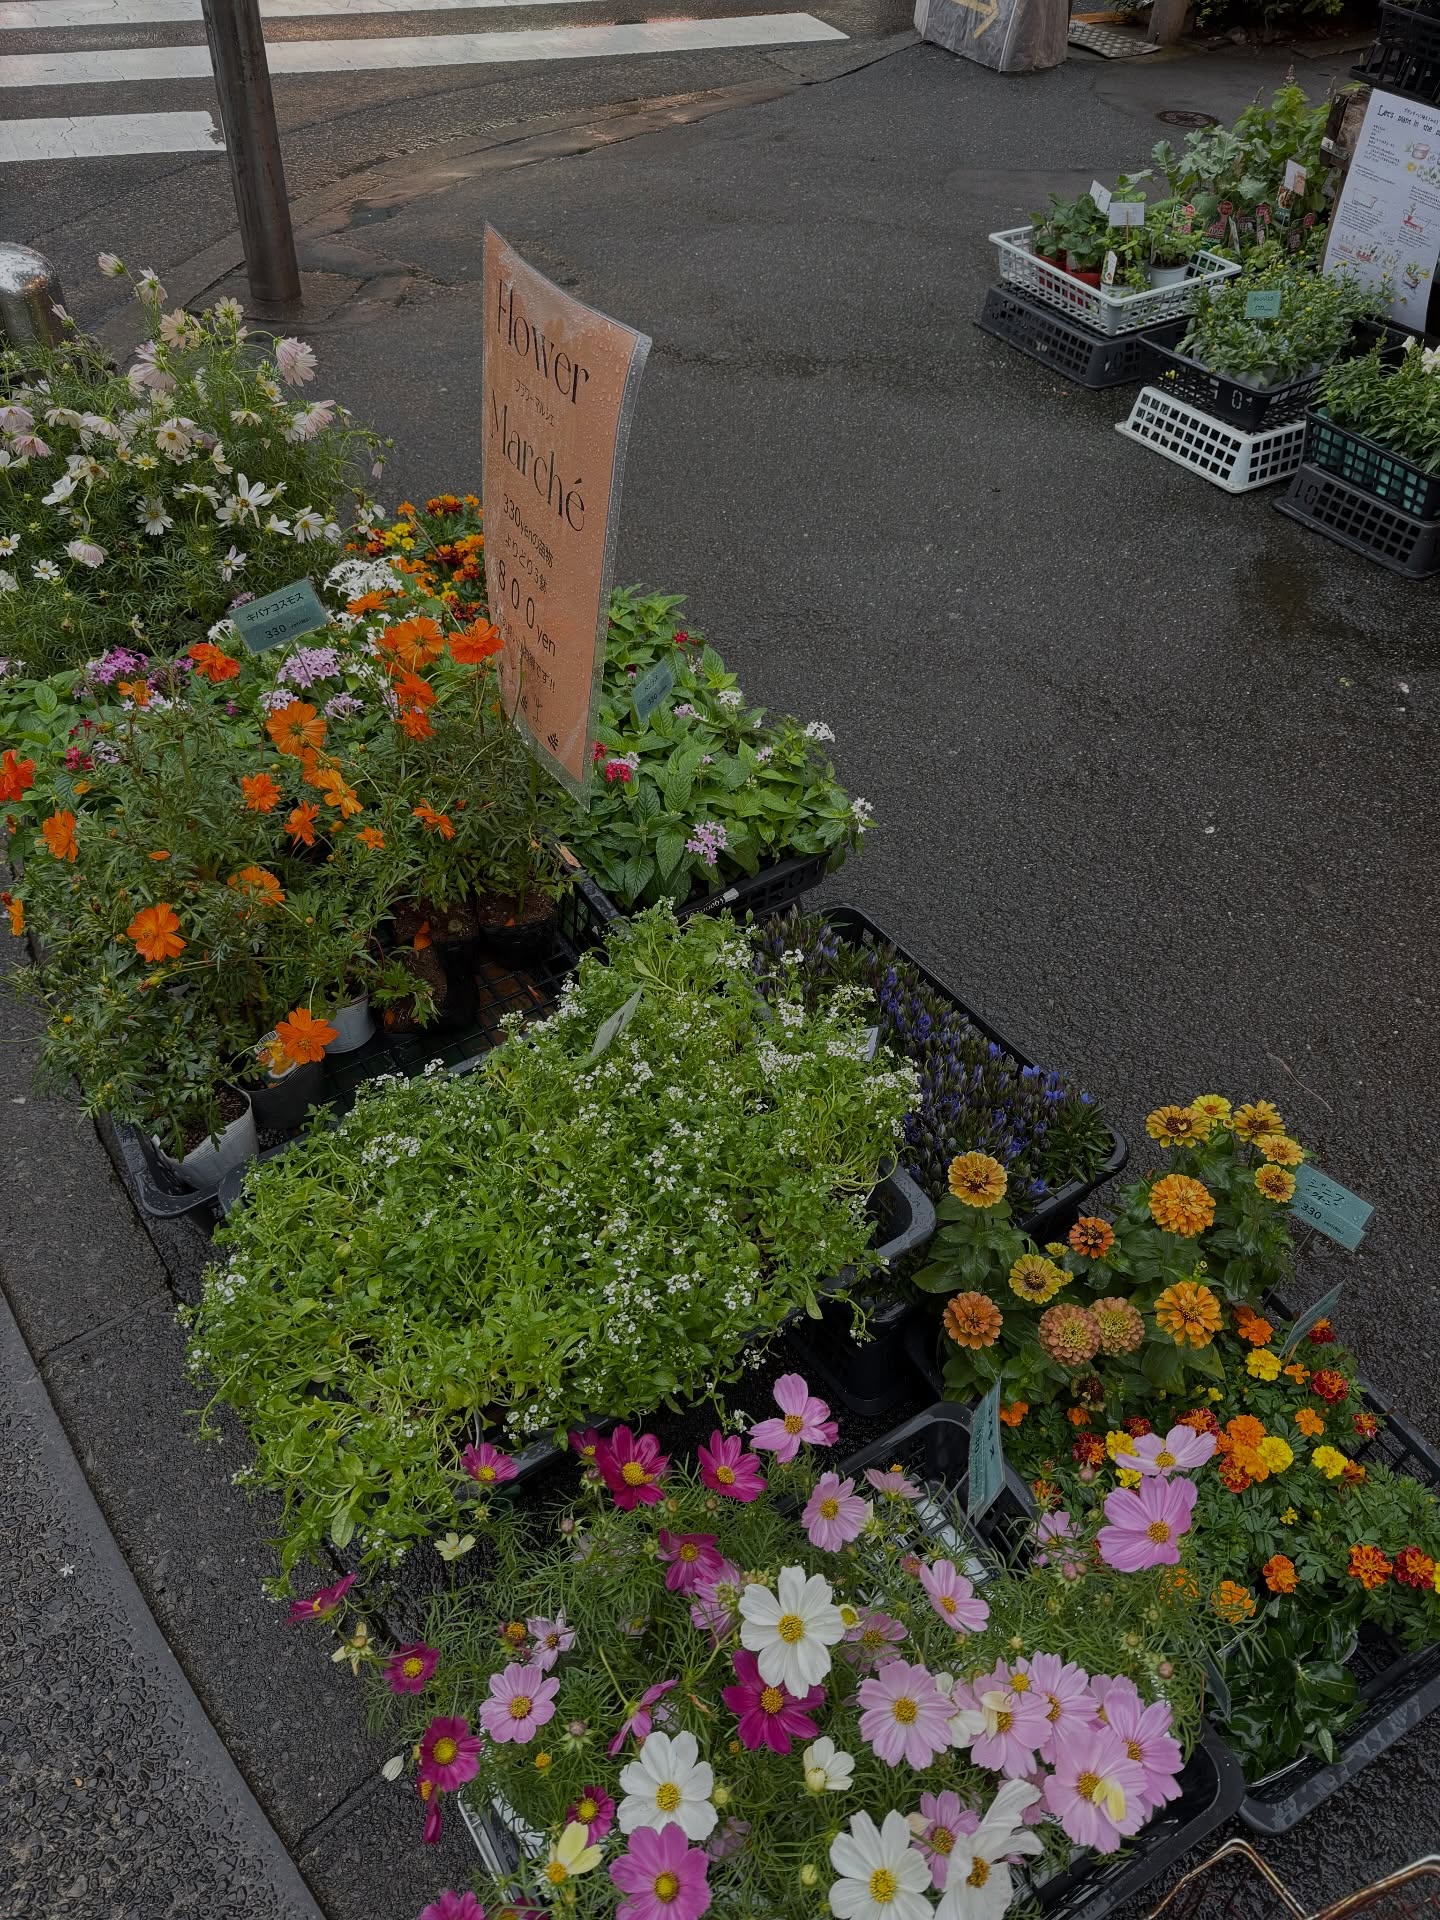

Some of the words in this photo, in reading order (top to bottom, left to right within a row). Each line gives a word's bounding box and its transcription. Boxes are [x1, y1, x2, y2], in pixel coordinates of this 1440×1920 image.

[497, 279, 590, 405] Flower
[491, 389, 585, 532] Marché
[246, 592, 304, 622] キバナコスモス
[264, 625, 287, 639] 330
[1307, 1178, 1345, 1202] ジニア
[1300, 1202, 1322, 1219] 330
